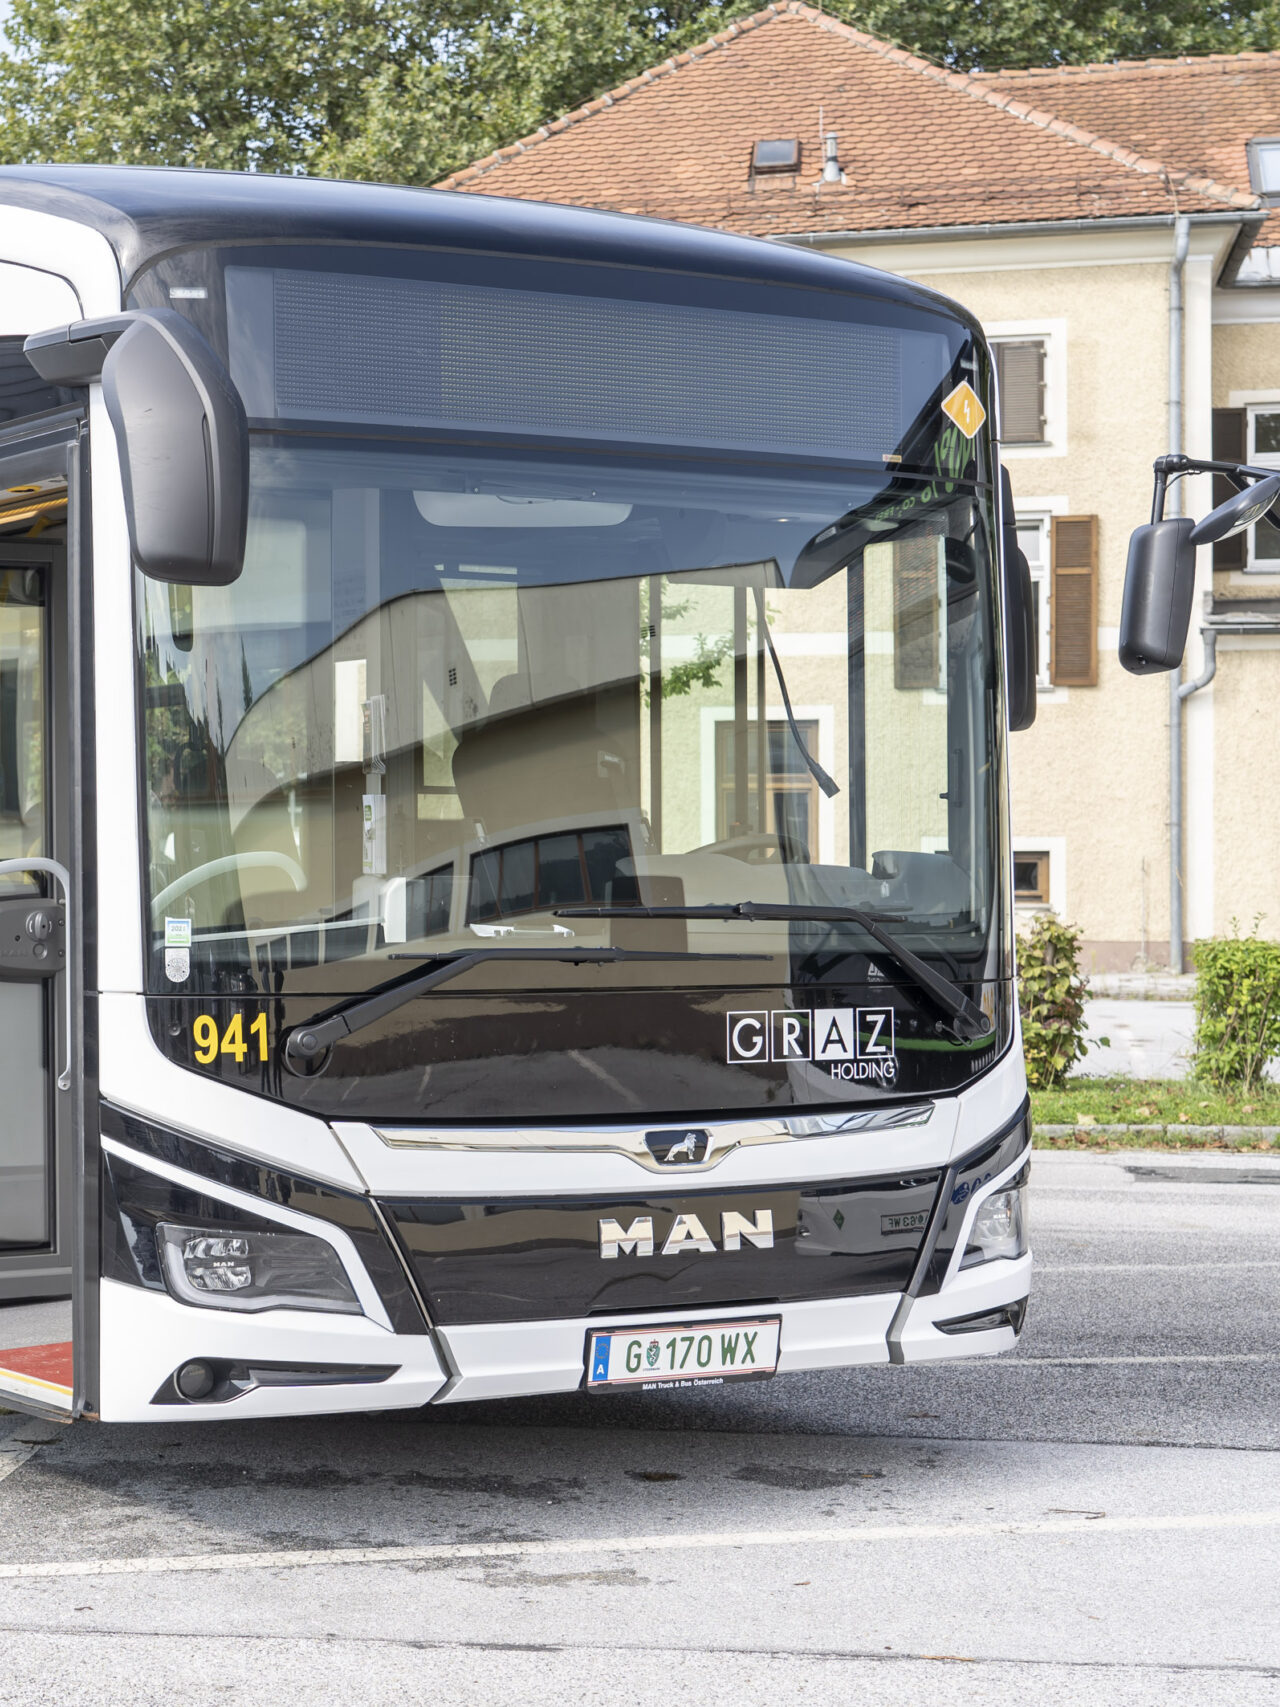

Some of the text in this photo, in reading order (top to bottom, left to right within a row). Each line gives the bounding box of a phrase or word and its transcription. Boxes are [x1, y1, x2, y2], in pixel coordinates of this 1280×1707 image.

[193, 1012, 268, 1064] 941
[729, 1010, 892, 1062] GRAZ
[830, 1061, 895, 1080] HOLDING
[598, 1209, 775, 1259] MAN
[596, 1364, 605, 1375] A
[625, 1331, 758, 1373] G 170 WX
[693, 1378, 724, 1386] Österreich
